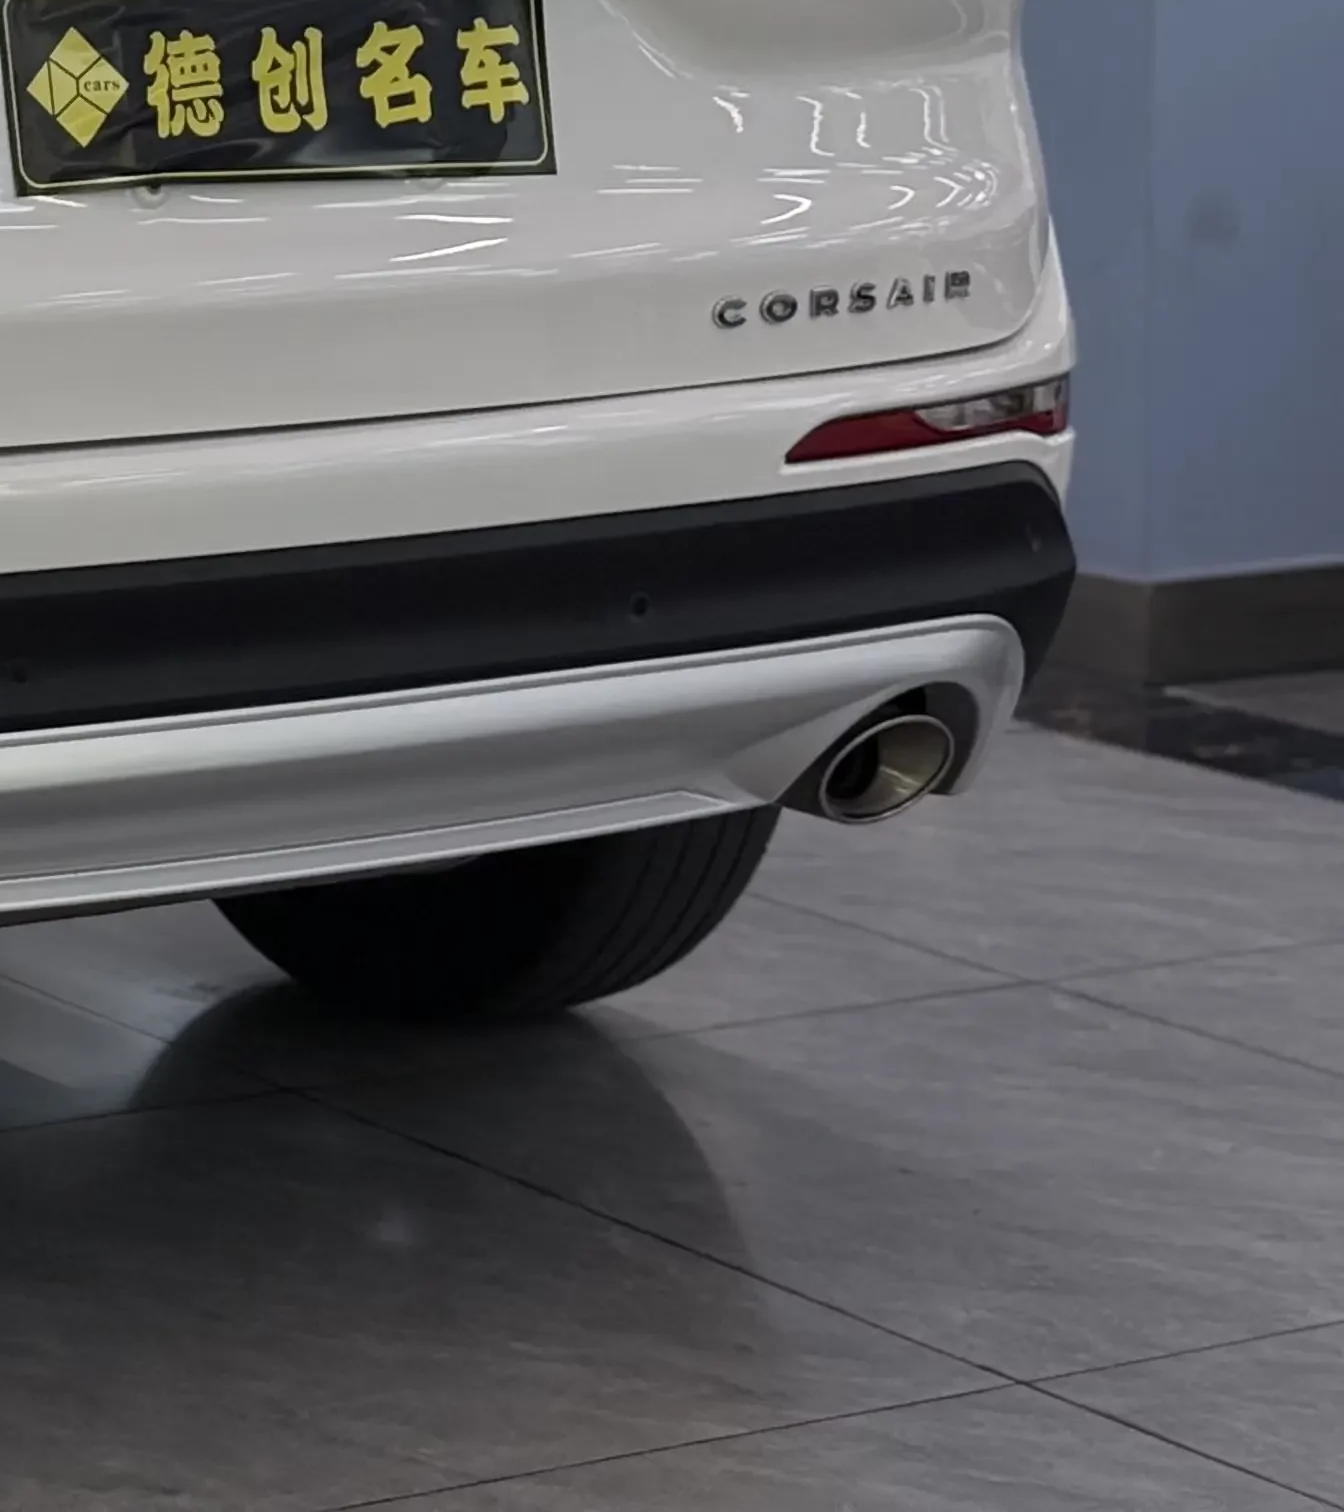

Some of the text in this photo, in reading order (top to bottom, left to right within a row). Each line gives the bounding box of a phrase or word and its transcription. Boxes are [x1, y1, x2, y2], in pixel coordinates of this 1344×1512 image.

[83, 80, 120, 92] cars
[143, 17, 531, 139] 德创名车
[712, 270, 971, 330] CORSAIR
